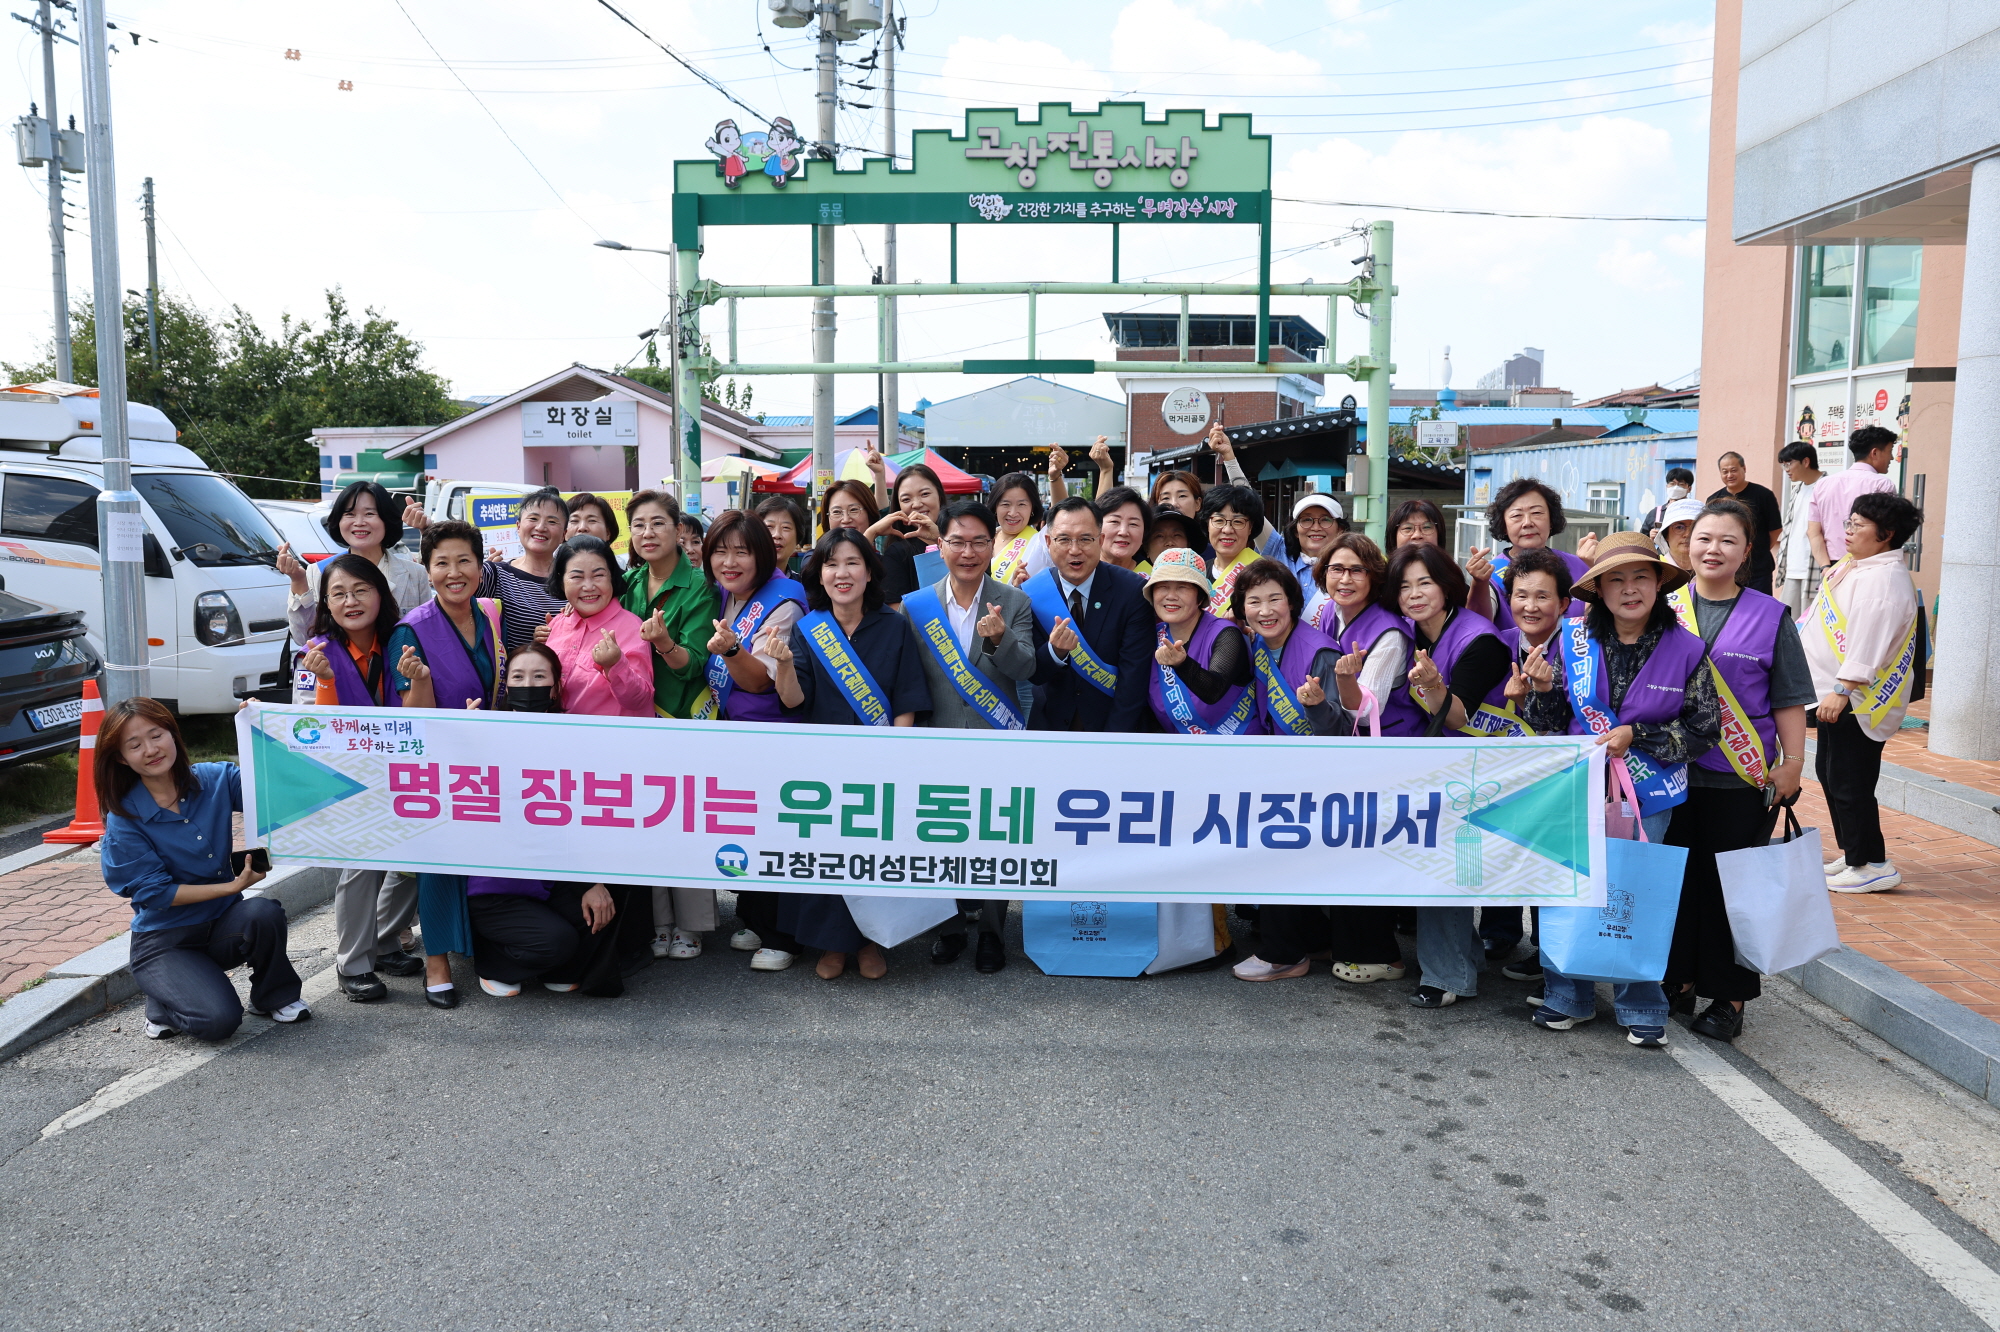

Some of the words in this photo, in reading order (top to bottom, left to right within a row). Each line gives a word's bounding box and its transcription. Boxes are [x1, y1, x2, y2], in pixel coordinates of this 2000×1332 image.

[965, 120, 1198, 188] 고창전통시장
[819, 203, 843, 218] 동문
[1017, 202, 1051, 218] 건강한
[1053, 202, 1088, 217] 가치를
[1089, 201, 1136, 217] 추구하는
[547, 406, 612, 427] 화장실
[1168, 414, 1206, 424] 먹거리골목
[567, 430, 593, 438] toilet
[1022, 419, 1069, 435] 전통시장
[480, 503, 507, 522] 추석연휴
[9, 555, 40, 564] BONGO
[34, 648, 55, 659] KIA
[810, 621, 872, 702] 군민활력지원금
[923, 617, 983, 696] 군민활력지원금
[974, 689, 1000, 713] 쓰고
[331, 718, 381, 735] 함께여는
[384, 720, 412, 736] 미래
[346, 737, 396, 753] 도약하는
[398, 739, 425, 755] 고창
[388, 762, 501, 824] 명절
[522, 768, 757, 836] 장보기는
[778, 780, 895, 841] 우리
[916, 784, 1036, 846] 동네
[1054, 789, 1175, 848] 우리
[1193, 790, 1442, 850] 시장에서
[759, 851, 1058, 888] 고창군여성단체협의회
